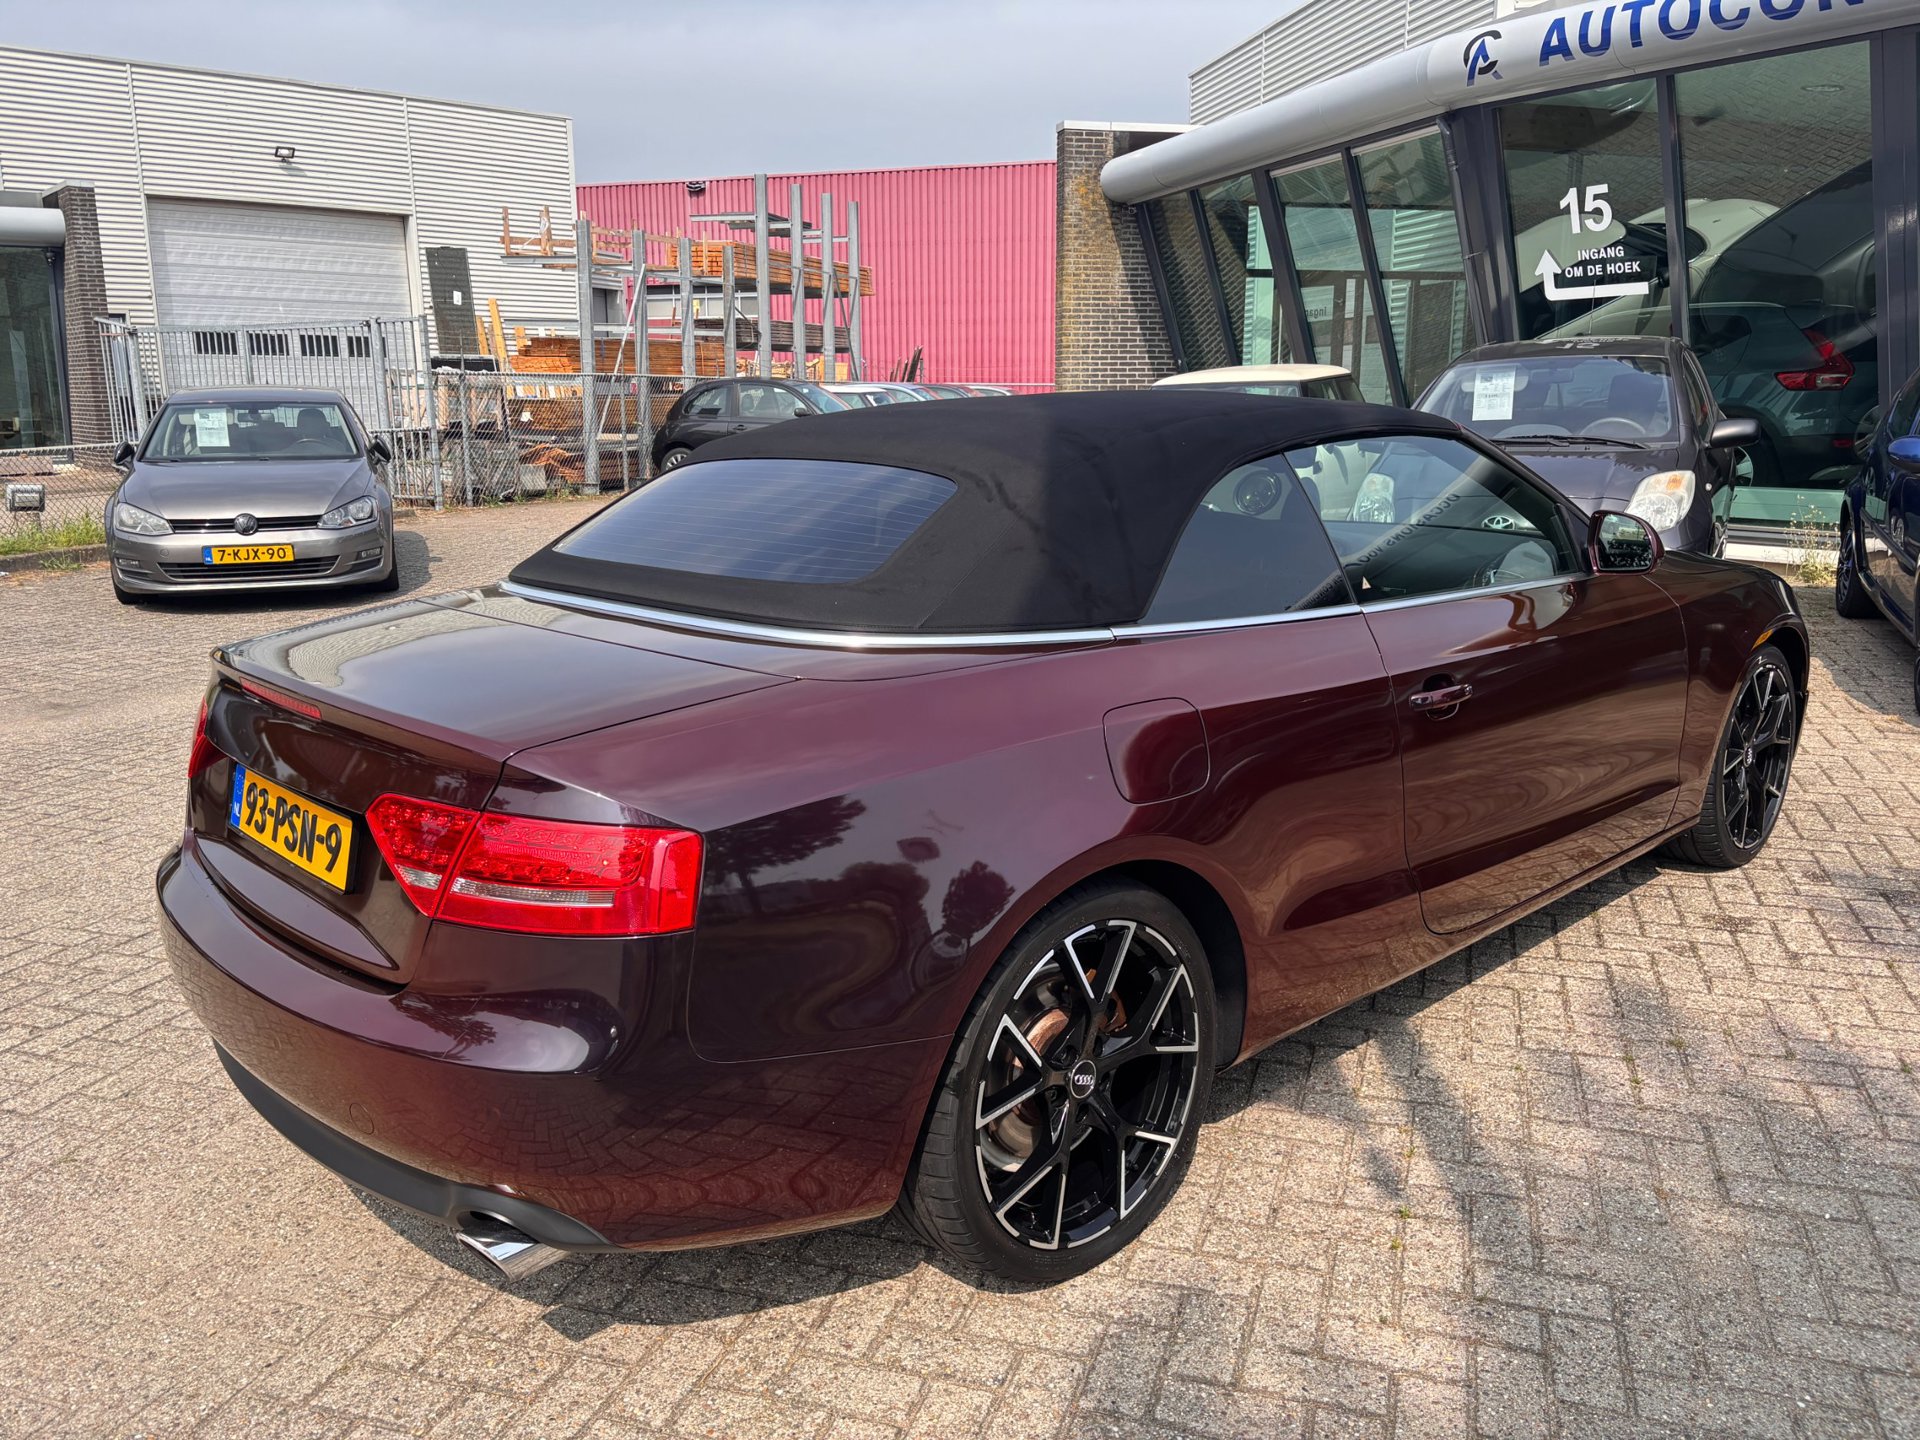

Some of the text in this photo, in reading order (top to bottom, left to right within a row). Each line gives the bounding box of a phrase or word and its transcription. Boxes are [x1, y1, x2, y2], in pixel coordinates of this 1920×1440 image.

[1560, 183, 1613, 234] 15
[1577, 246, 1625, 261] INGANG
[1565, 260, 1641, 278] OM DE HOEK
[217, 547, 287, 562] 7-KJX-90
[233, 802, 240, 818] NL
[245, 782, 342, 873] 93-PSN-9
